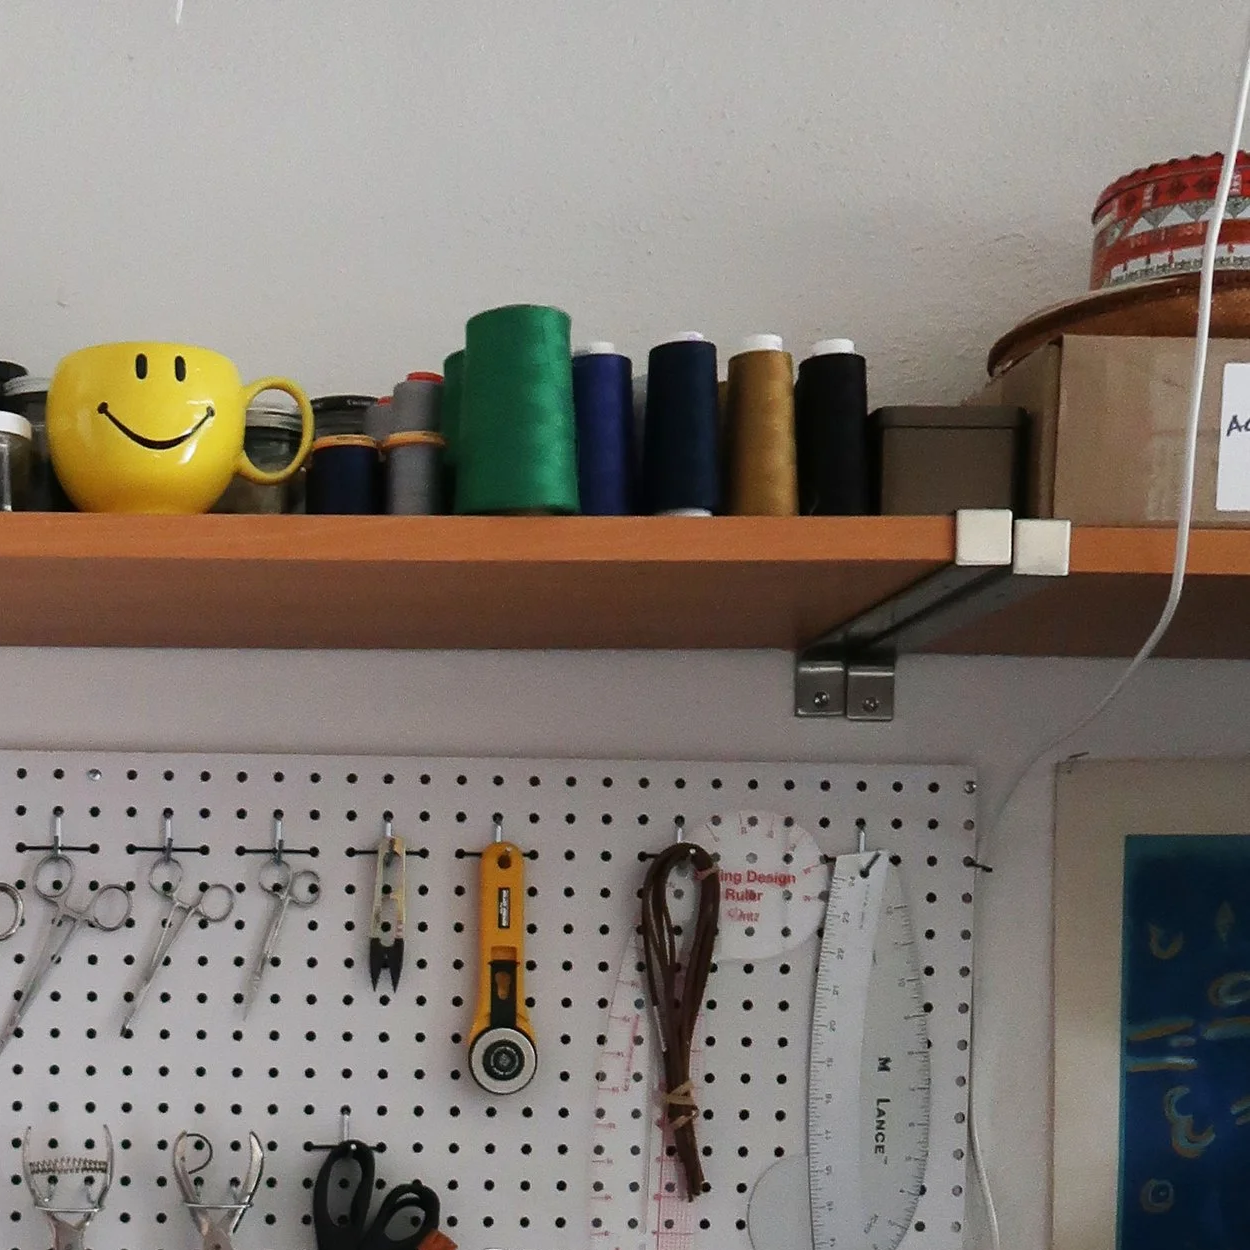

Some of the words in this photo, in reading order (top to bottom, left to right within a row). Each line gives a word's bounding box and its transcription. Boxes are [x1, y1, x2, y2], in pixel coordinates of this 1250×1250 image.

[747, 870, 796, 887] Design
[726, 888, 763, 901] Ruler
[877, 1056, 892, 1073] M
